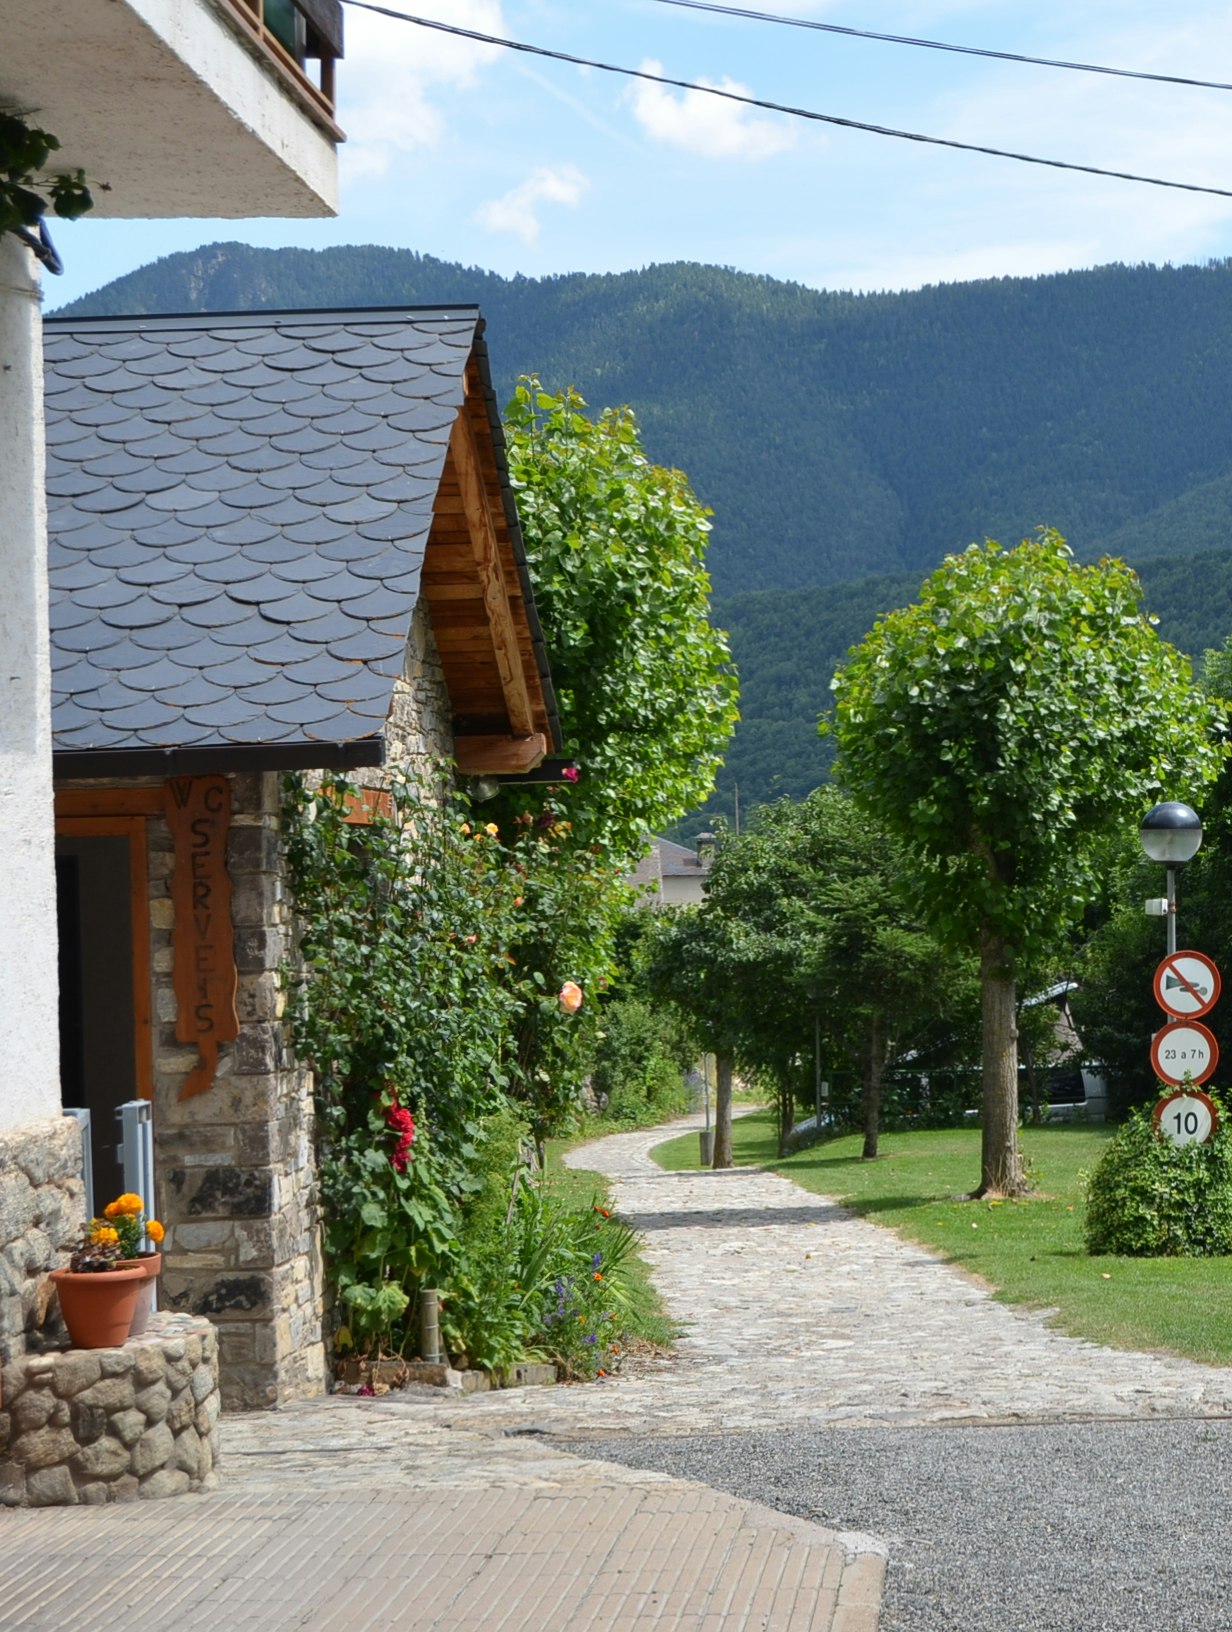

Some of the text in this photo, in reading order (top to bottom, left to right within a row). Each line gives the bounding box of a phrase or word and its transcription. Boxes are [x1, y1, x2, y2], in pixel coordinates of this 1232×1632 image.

[1164, 1049, 1176, 1060] 23
[1181, 1051, 1187, 1060] a
[1190, 1049, 1197, 1060] 7
[1173, 1112, 1198, 1135] 10
